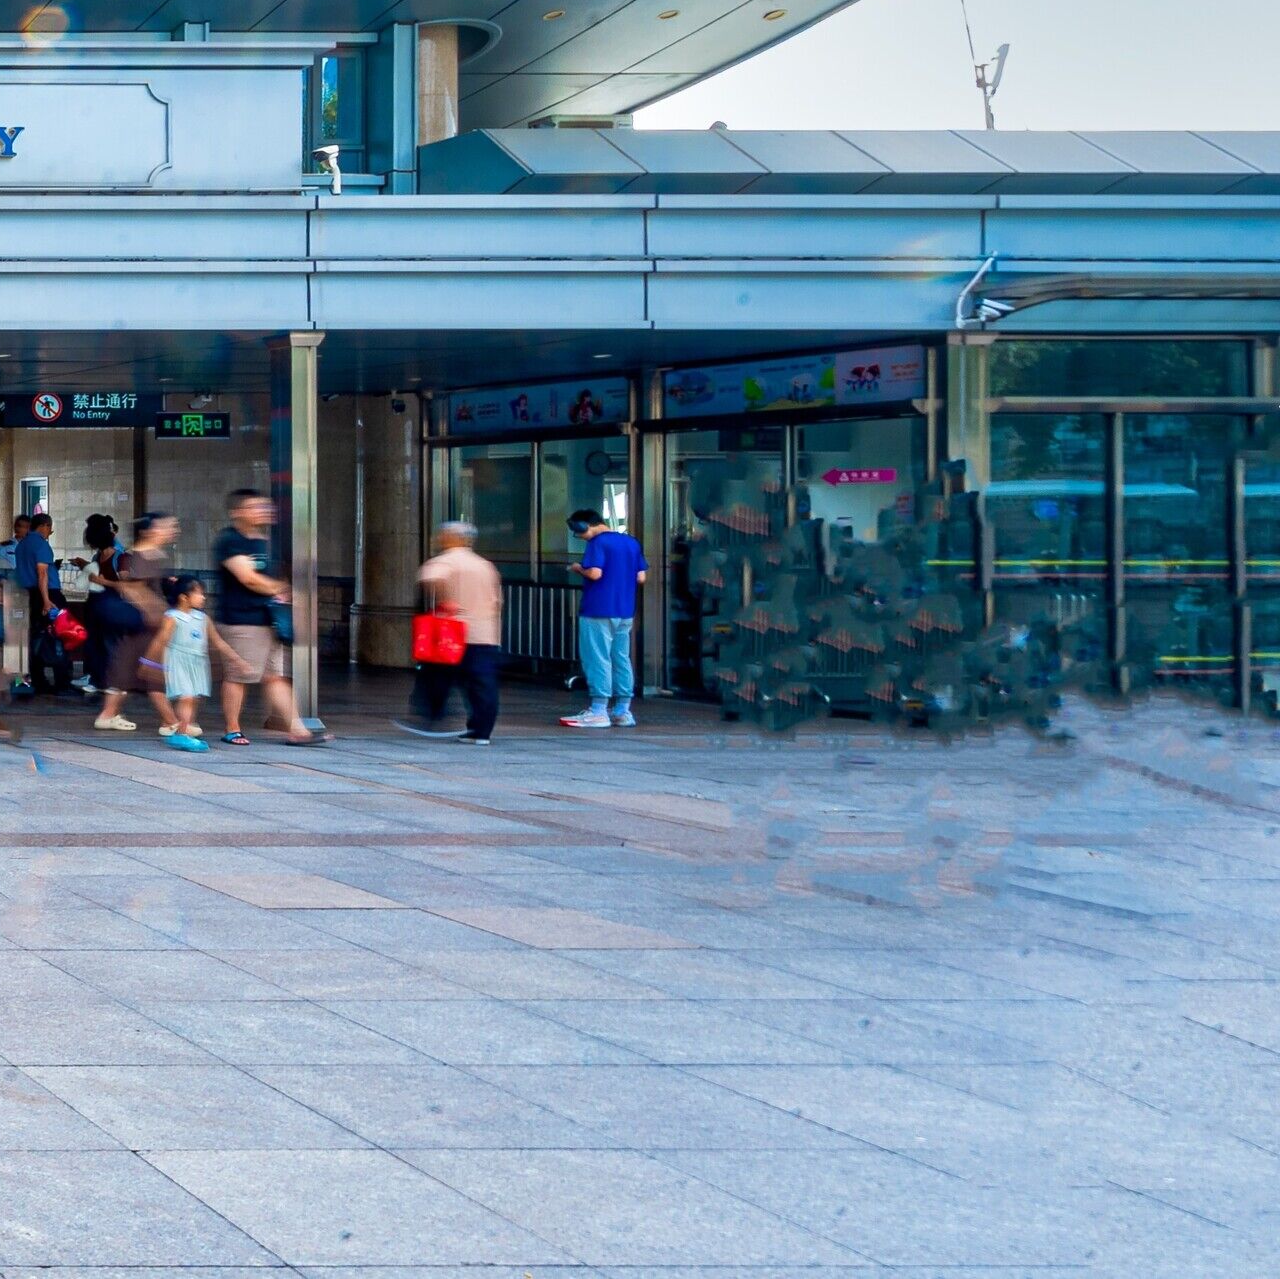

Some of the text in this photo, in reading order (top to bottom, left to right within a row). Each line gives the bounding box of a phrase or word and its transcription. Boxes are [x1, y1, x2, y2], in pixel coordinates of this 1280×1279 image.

[73, 393, 138, 409] 禁止通行
[73, 410, 111, 421] No Entry
[204, 419, 222, 429] 出口
